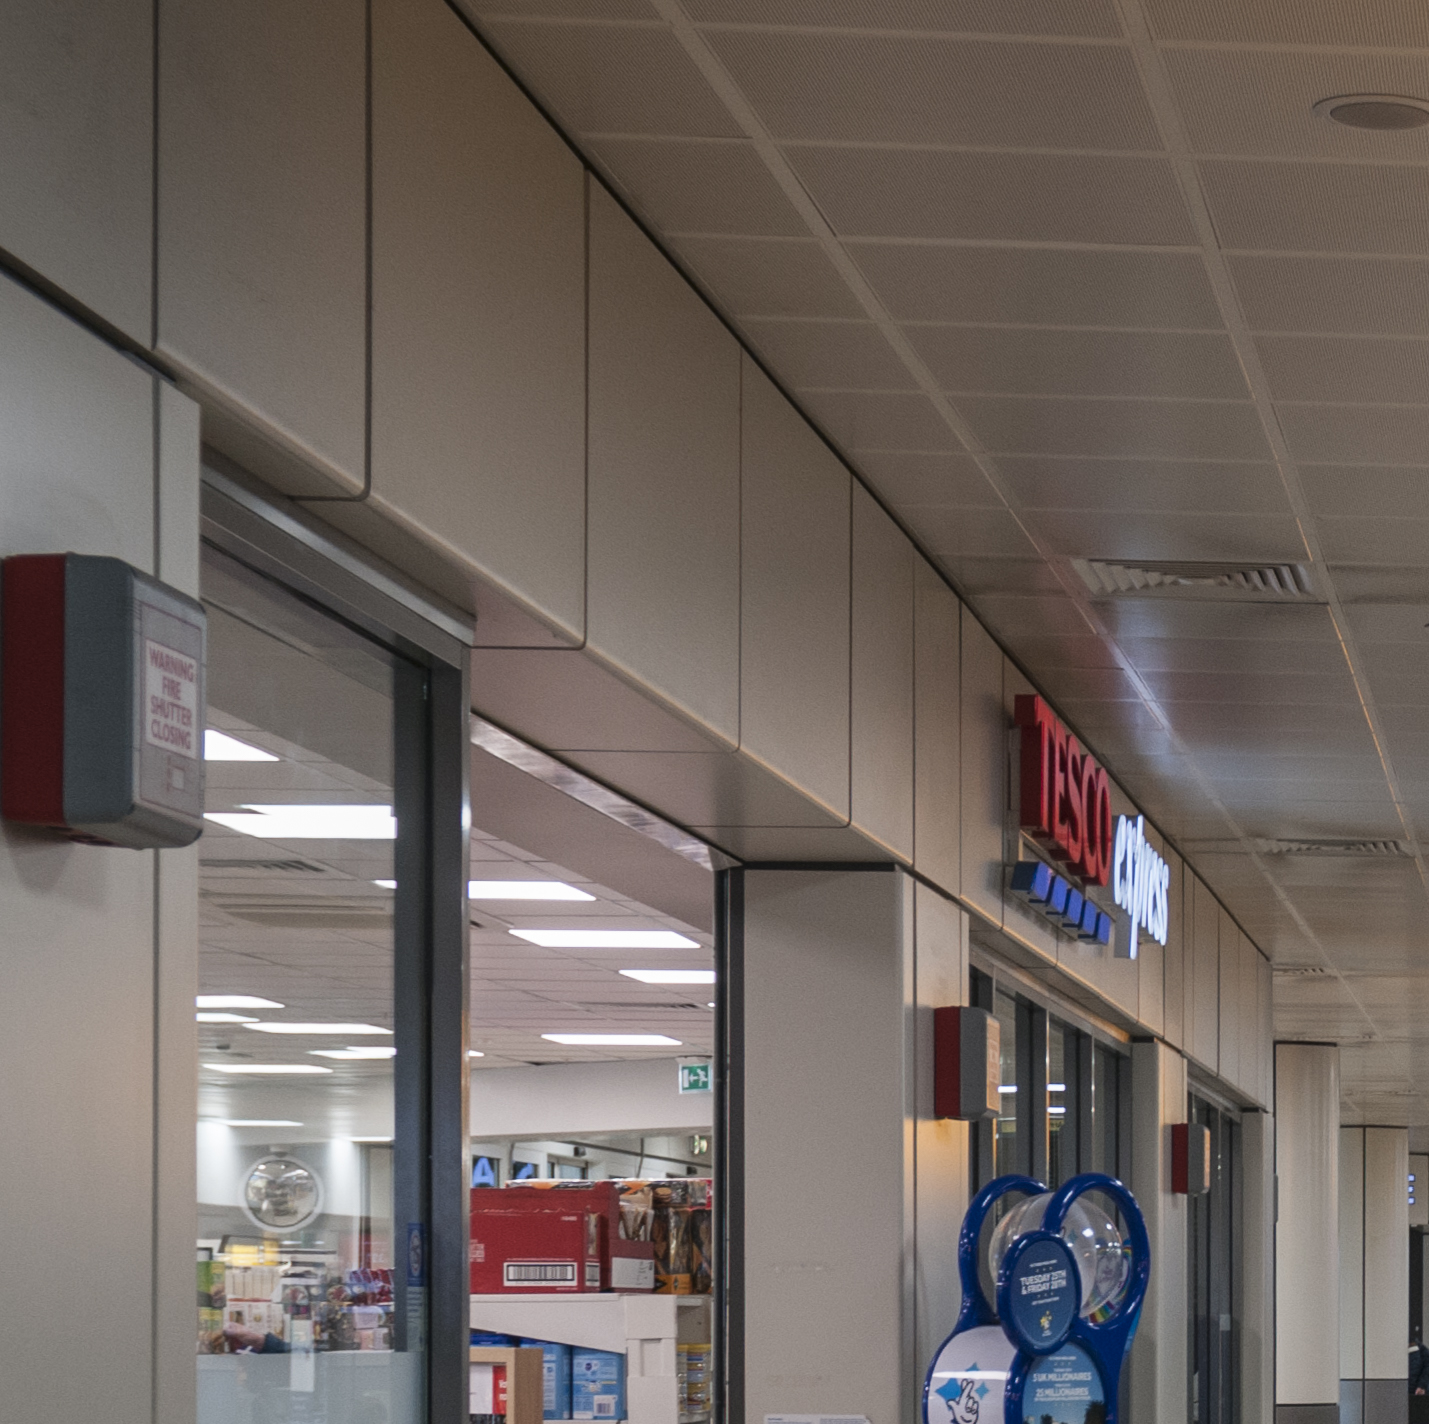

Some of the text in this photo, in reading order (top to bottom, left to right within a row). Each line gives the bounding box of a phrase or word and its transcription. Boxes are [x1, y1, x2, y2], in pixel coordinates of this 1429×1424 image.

[149, 645, 194, 683] WARNING
[162, 675, 182, 701] FIRE
[150, 694, 192, 727] SHUTTER
[150, 718, 192, 750] CLOSING
[1026, 693, 1112, 888] TESCO
[1020, 1272, 1051, 1286] TUESDAY
[1027, 1281, 1051, 1295] FRIDAY
